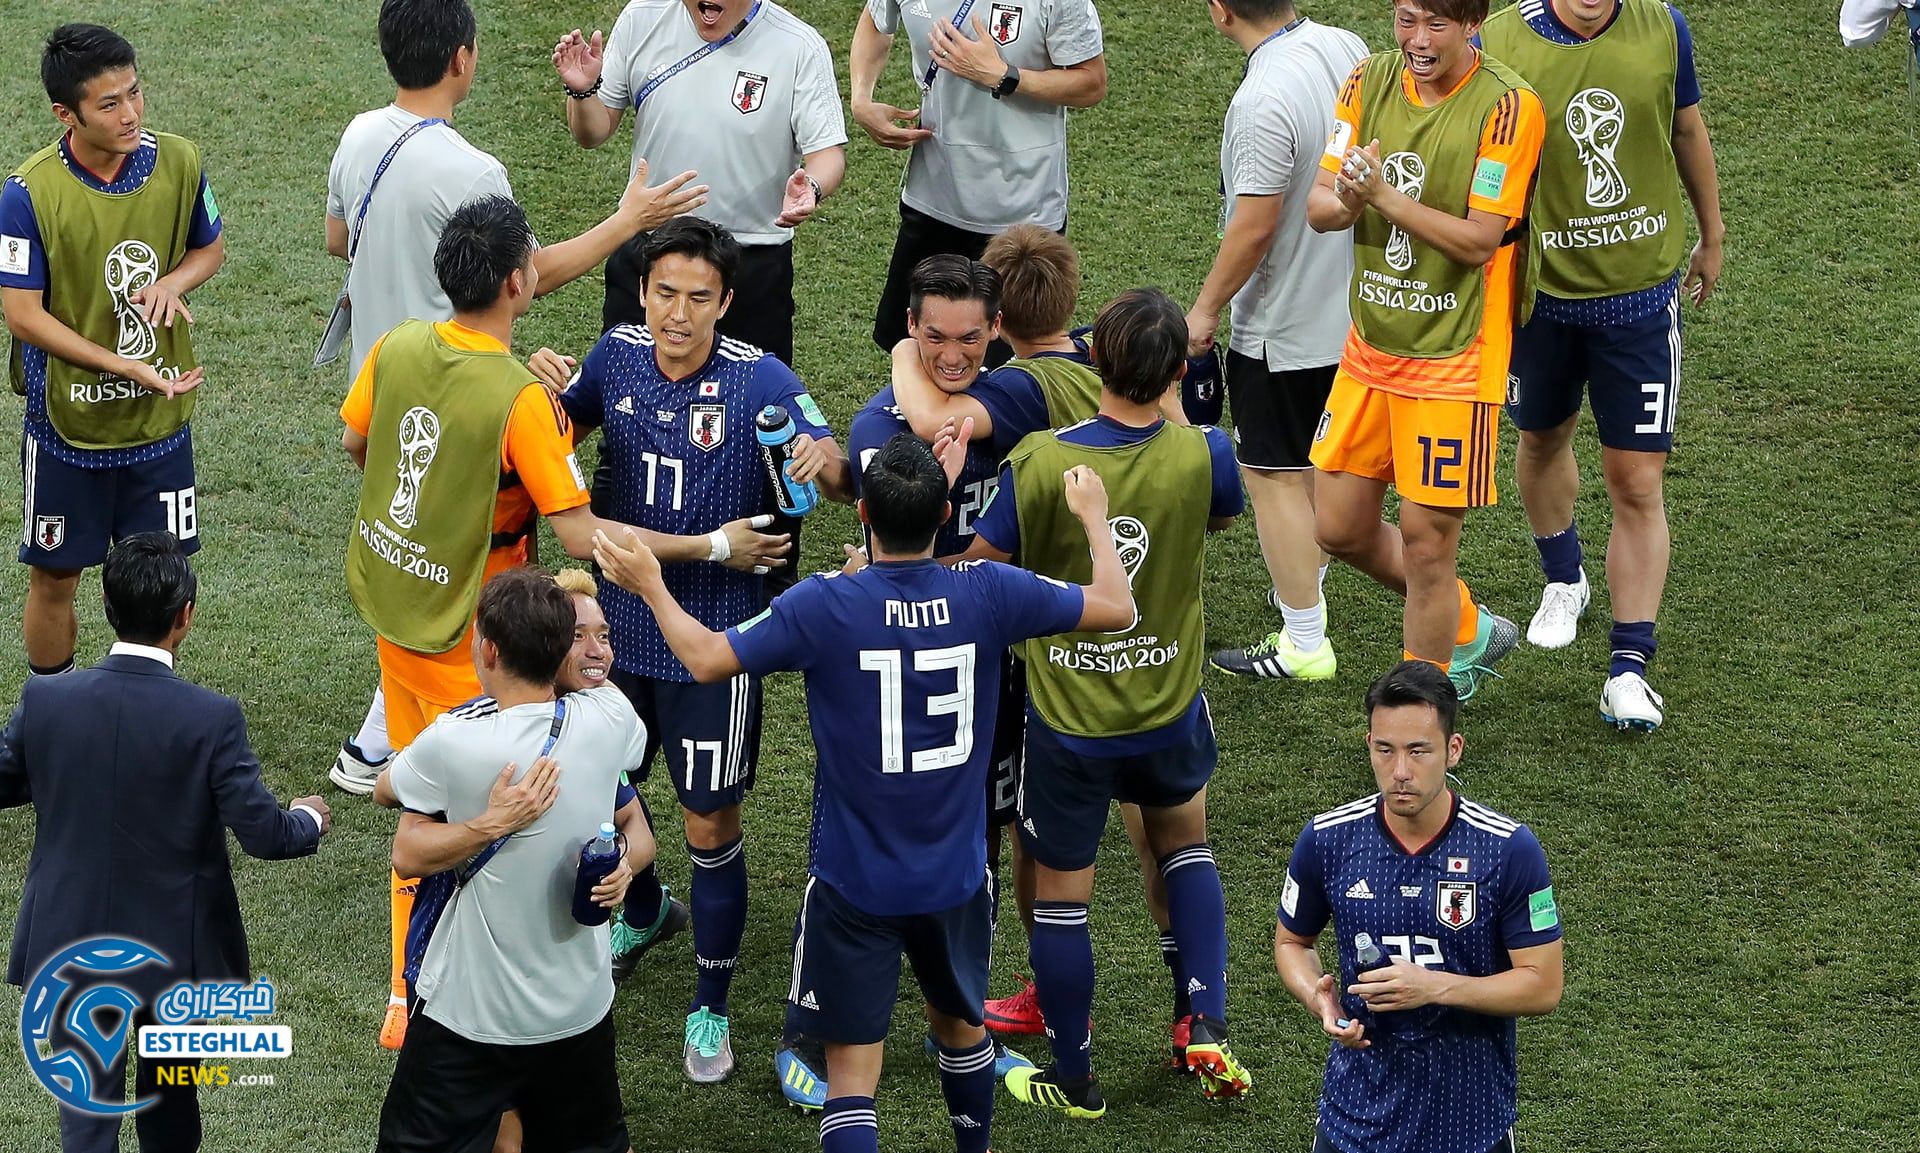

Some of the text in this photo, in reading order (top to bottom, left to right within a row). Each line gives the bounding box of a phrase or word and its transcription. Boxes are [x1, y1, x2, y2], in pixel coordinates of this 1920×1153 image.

[1568, 205, 1647, 227] FIFA WORLD CUP
[1541, 224, 1627, 250] RUSSIA
[1363, 270, 1428, 291] FIFA WORLD CUP
[1407, 292, 1457, 313] 2018
[1634, 383, 1665, 434] 3
[762, 445, 787, 508] POWERADE
[1418, 435, 1462, 488] 12
[641, 451, 683, 511] 17
[159, 486, 197, 540] 18
[360, 519, 449, 585] RUSSIA 2018
[374, 518, 426, 554] FIFA WORLD CUP
[885, 597, 950, 628] MUTO
[1049, 640, 1179, 674] RUSSIA 2018
[1077, 636, 1158, 653] FIFA WORLD CUP
[859, 643, 976, 773] 13
[682, 738, 722, 791] 17
[1345, 891, 1374, 899] adidas
